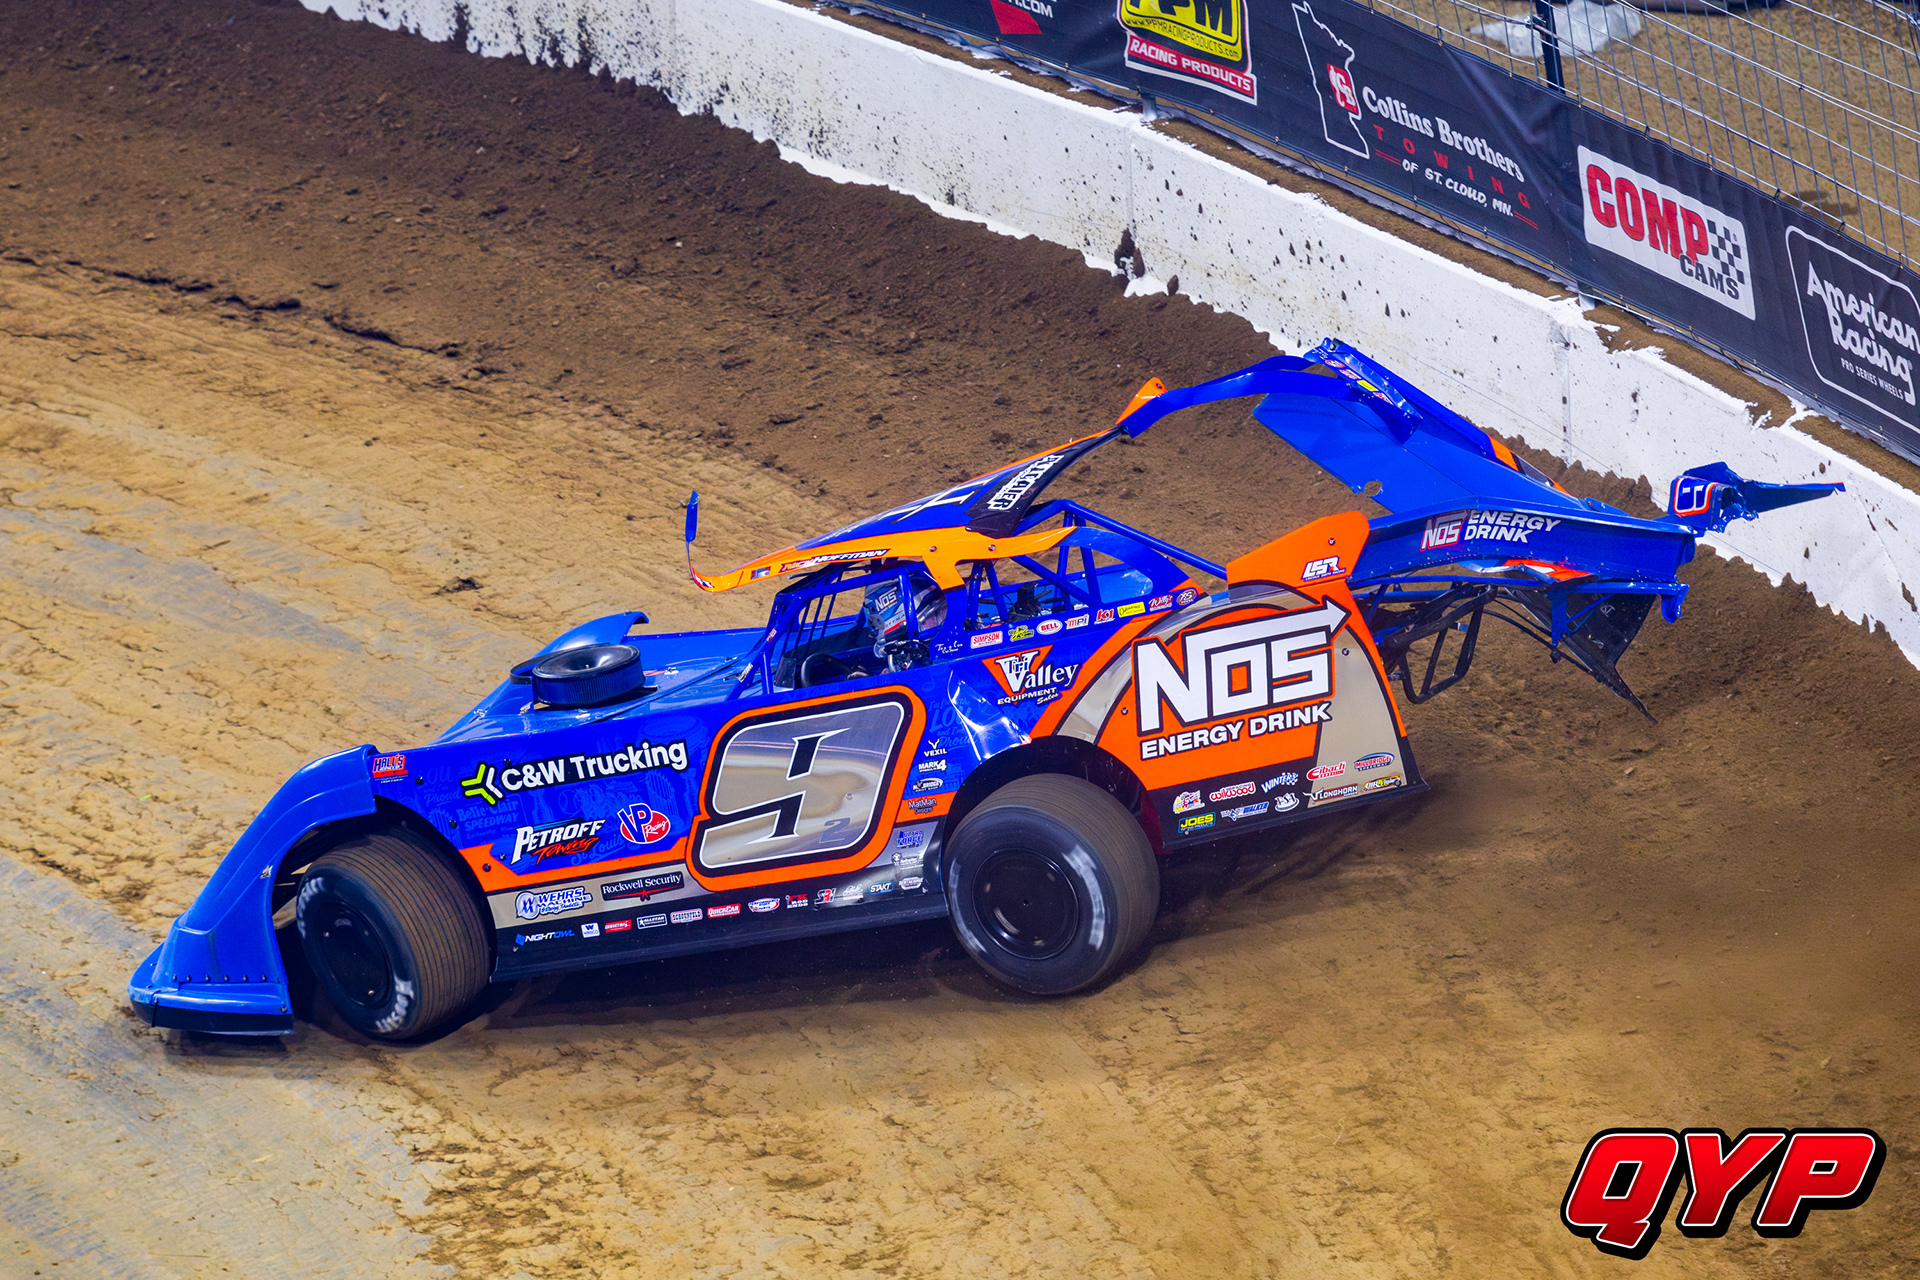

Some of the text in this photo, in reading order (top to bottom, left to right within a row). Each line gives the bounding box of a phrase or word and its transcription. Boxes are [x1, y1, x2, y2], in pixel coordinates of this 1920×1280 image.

[1130, 39, 1250, 91] RACING PRODUCTS
[1363, 86, 1524, 182] Collins Brothers
[1373, 124, 1530, 209] TOWING
[1402, 159, 1514, 217] OF ST. CLOUD, MN.
[1587, 164, 1709, 265] COMP
[1679, 254, 1740, 300] CAMS
[1807, 260, 1920, 355] American
[1831, 309, 1916, 406] Racing
[1841, 357, 1903, 400] PRO SERIES WHEELS
[1421, 510, 1561, 550] NOS ENERGY
[1464, 525, 1533, 543] DRINK
[813, 549, 888, 563] HOFFMAN
[1303, 556, 1339, 578] LSR
[875, 587, 898, 612] NOS
[1180, 592, 1193, 602] XS
[1097, 609, 1114, 620] K1
[1041, 623, 1059, 631] BELL
[973, 633, 1000, 644] SIMPSON
[995, 651, 1079, 693] Valley
[1005, 658, 1030, 674] Tri
[1137, 606, 1335, 731] NOS
[997, 687, 1057, 705] EQUIPMENT
[1037, 693, 1059, 705] Sales
[1142, 703, 1331, 759] ENERGY DRINK
[924, 748, 947, 757] VEXIL
[1356, 757, 1390, 768] MILLBRIDGE
[501, 741, 688, 791] C&W Trucking
[1307, 761, 1345, 780] Eibach
[699, 702, 904, 869] 9
[1211, 783, 1255, 800] wilwood
[1261, 773, 1298, 793] WINTERS
[1320, 786, 1357, 799] LONGHORN
[908, 798, 937, 809] MatMan
[465, 812, 519, 831] SPEEDWAY
[617, 803, 653, 843] VP
[644, 819, 668, 836] Racing
[1181, 814, 1214, 827] JOES
[510, 819, 606, 865] PETROFF
[532, 837, 599, 865] Towing
[602, 874, 682, 894] Rockwell Security
[539, 888, 583, 903] WEHRS
[525, 930, 575, 942] NIGHTOWL
